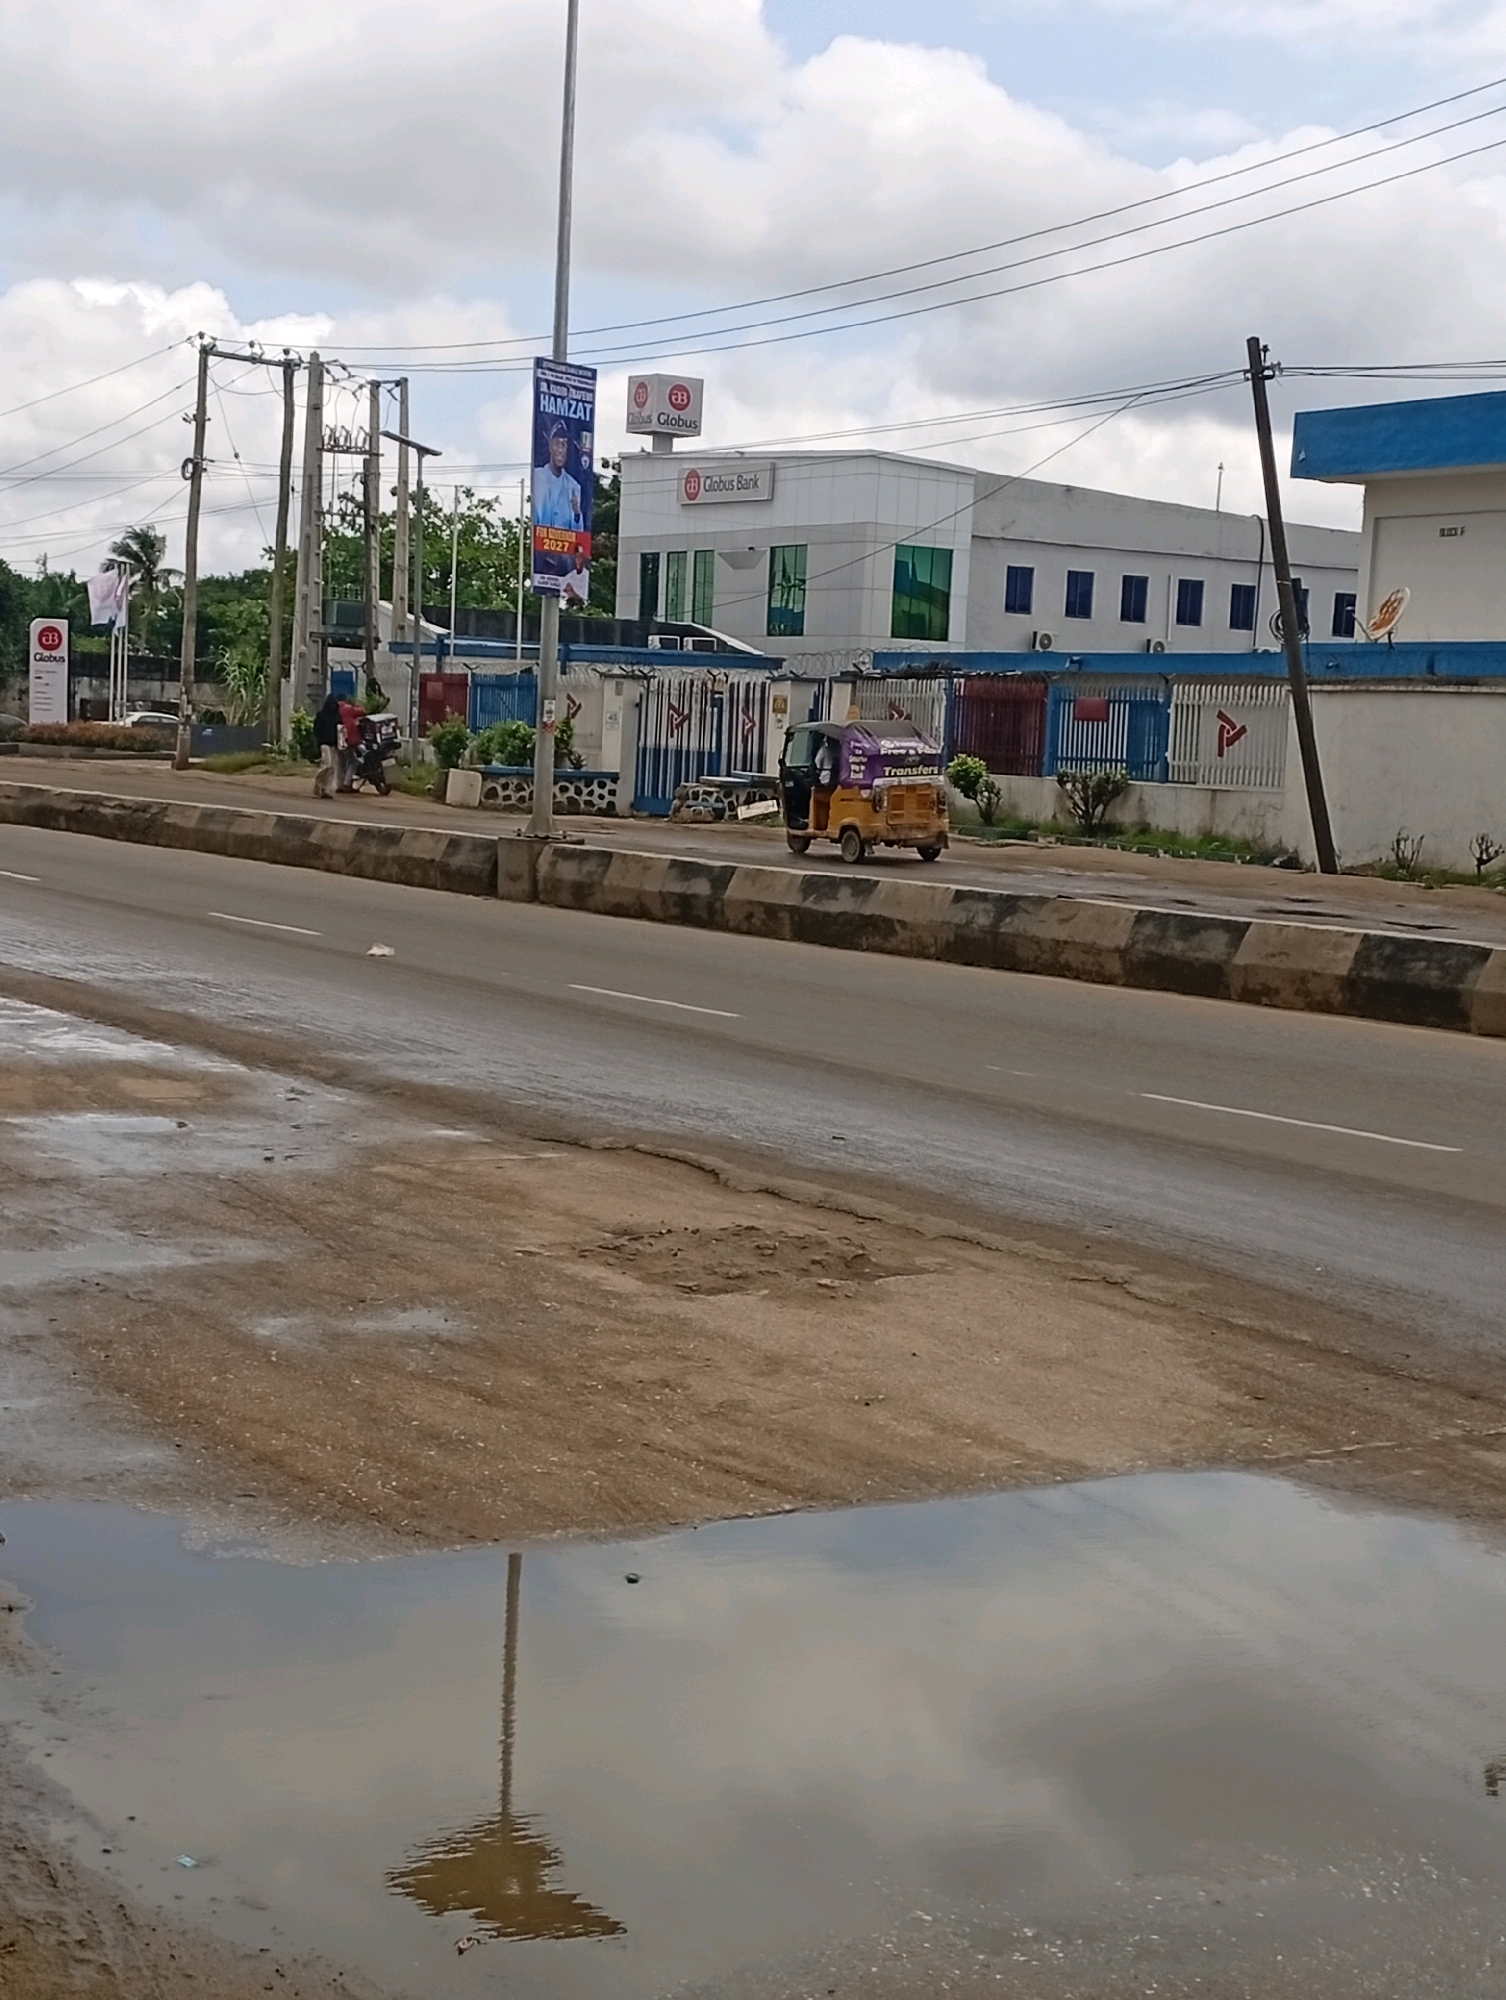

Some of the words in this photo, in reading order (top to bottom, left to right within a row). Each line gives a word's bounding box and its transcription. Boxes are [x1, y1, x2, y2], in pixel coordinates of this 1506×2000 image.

[540, 394, 593, 421] HAMZAT
[657, 411, 699, 430] Globus
[703, 475, 735, 492] Globus
[736, 473, 760, 491] Bank
[536, 526, 548, 538] FOR
[543, 538, 570, 552] 2027
[33, 652, 66, 663] Globus
[883, 764, 939, 776] Transfers
